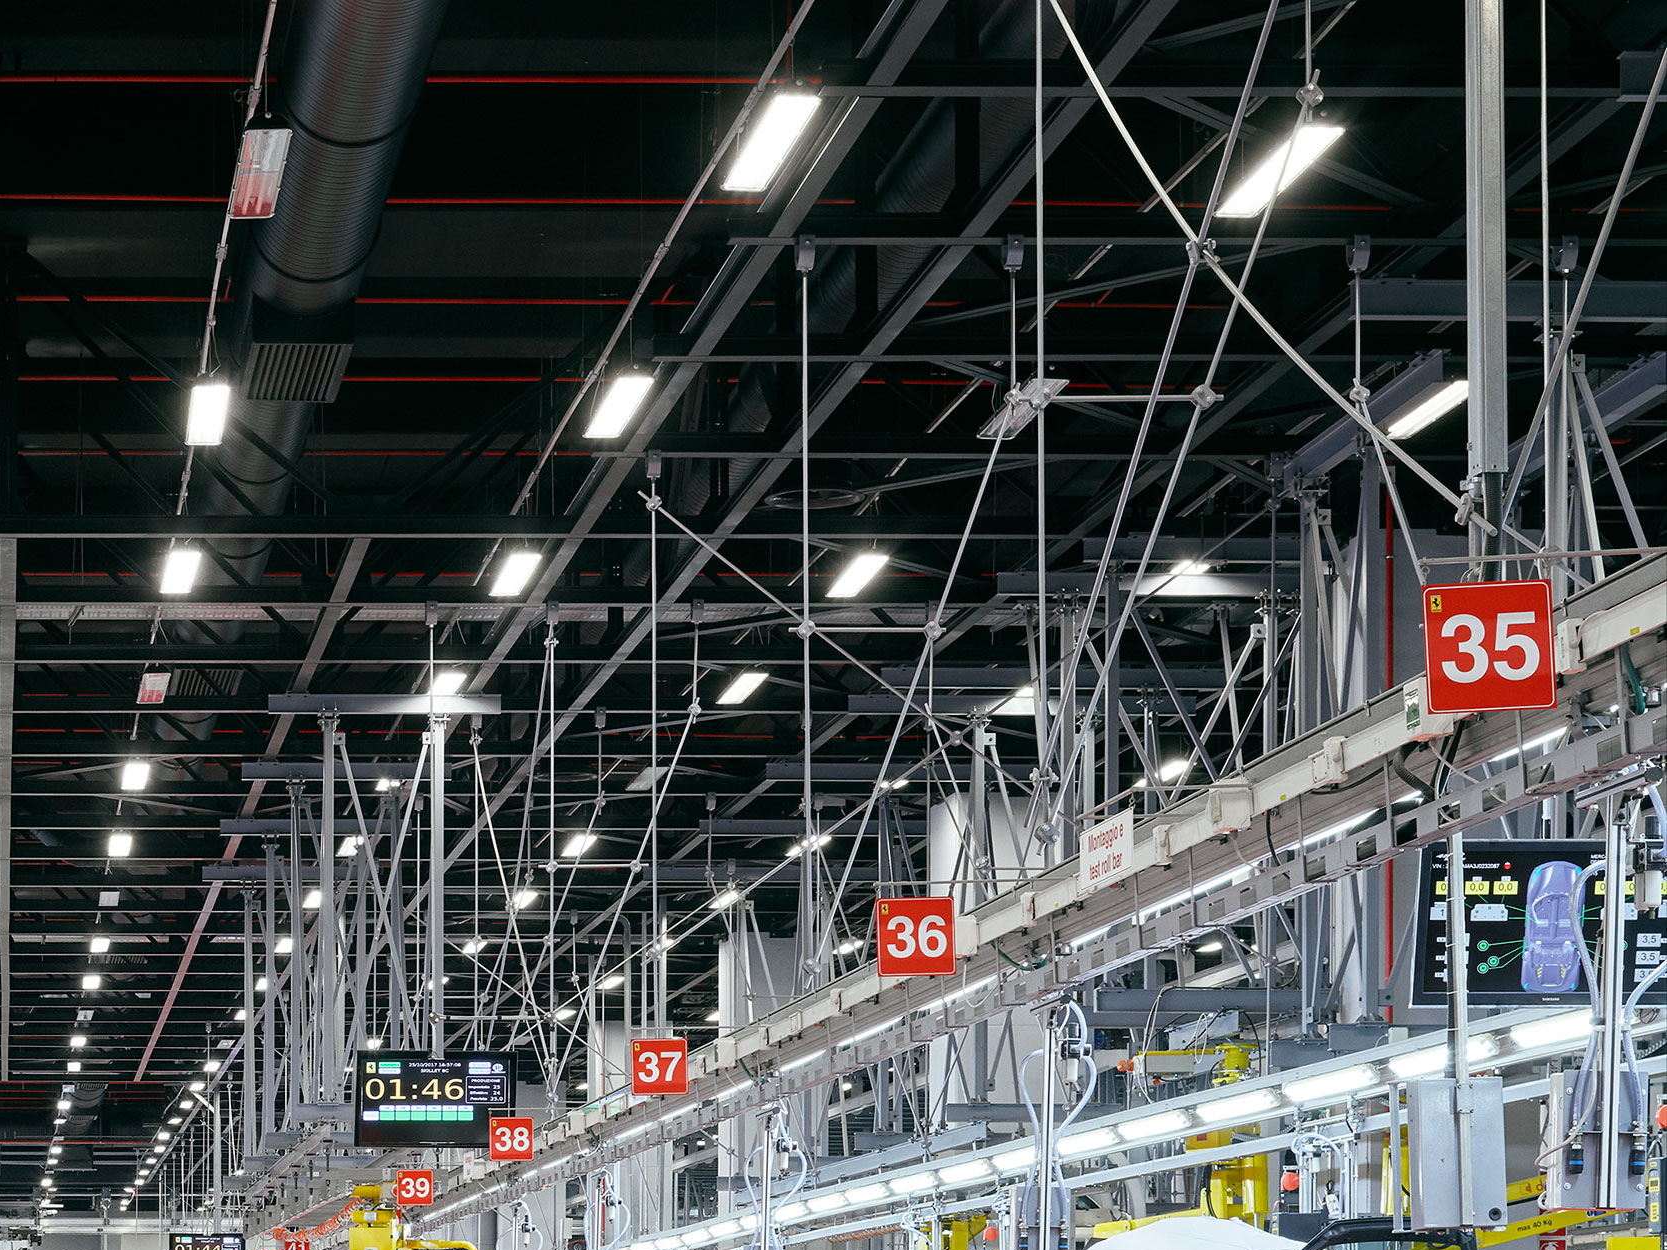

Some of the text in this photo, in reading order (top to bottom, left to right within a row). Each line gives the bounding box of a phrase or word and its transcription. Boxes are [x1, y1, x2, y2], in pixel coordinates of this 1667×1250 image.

[1441, 611, 1541, 684] 35
[1088, 823, 1124, 853] Montaggio e
[1089, 852, 1123, 880] test roll bar
[886, 914, 948, 959] 36
[1642, 934, 1657, 944] 3.5
[1640, 952, 1656, 962] 3.5
[637, 1051, 683, 1083] 37
[364, 1078, 465, 1100] 01:46
[494, 1126, 531, 1152] 38
[399, 1176, 431, 1199] 39
[1532, 1220, 1542, 1228] 40
[1543, 1218, 1553, 1226] Kg
